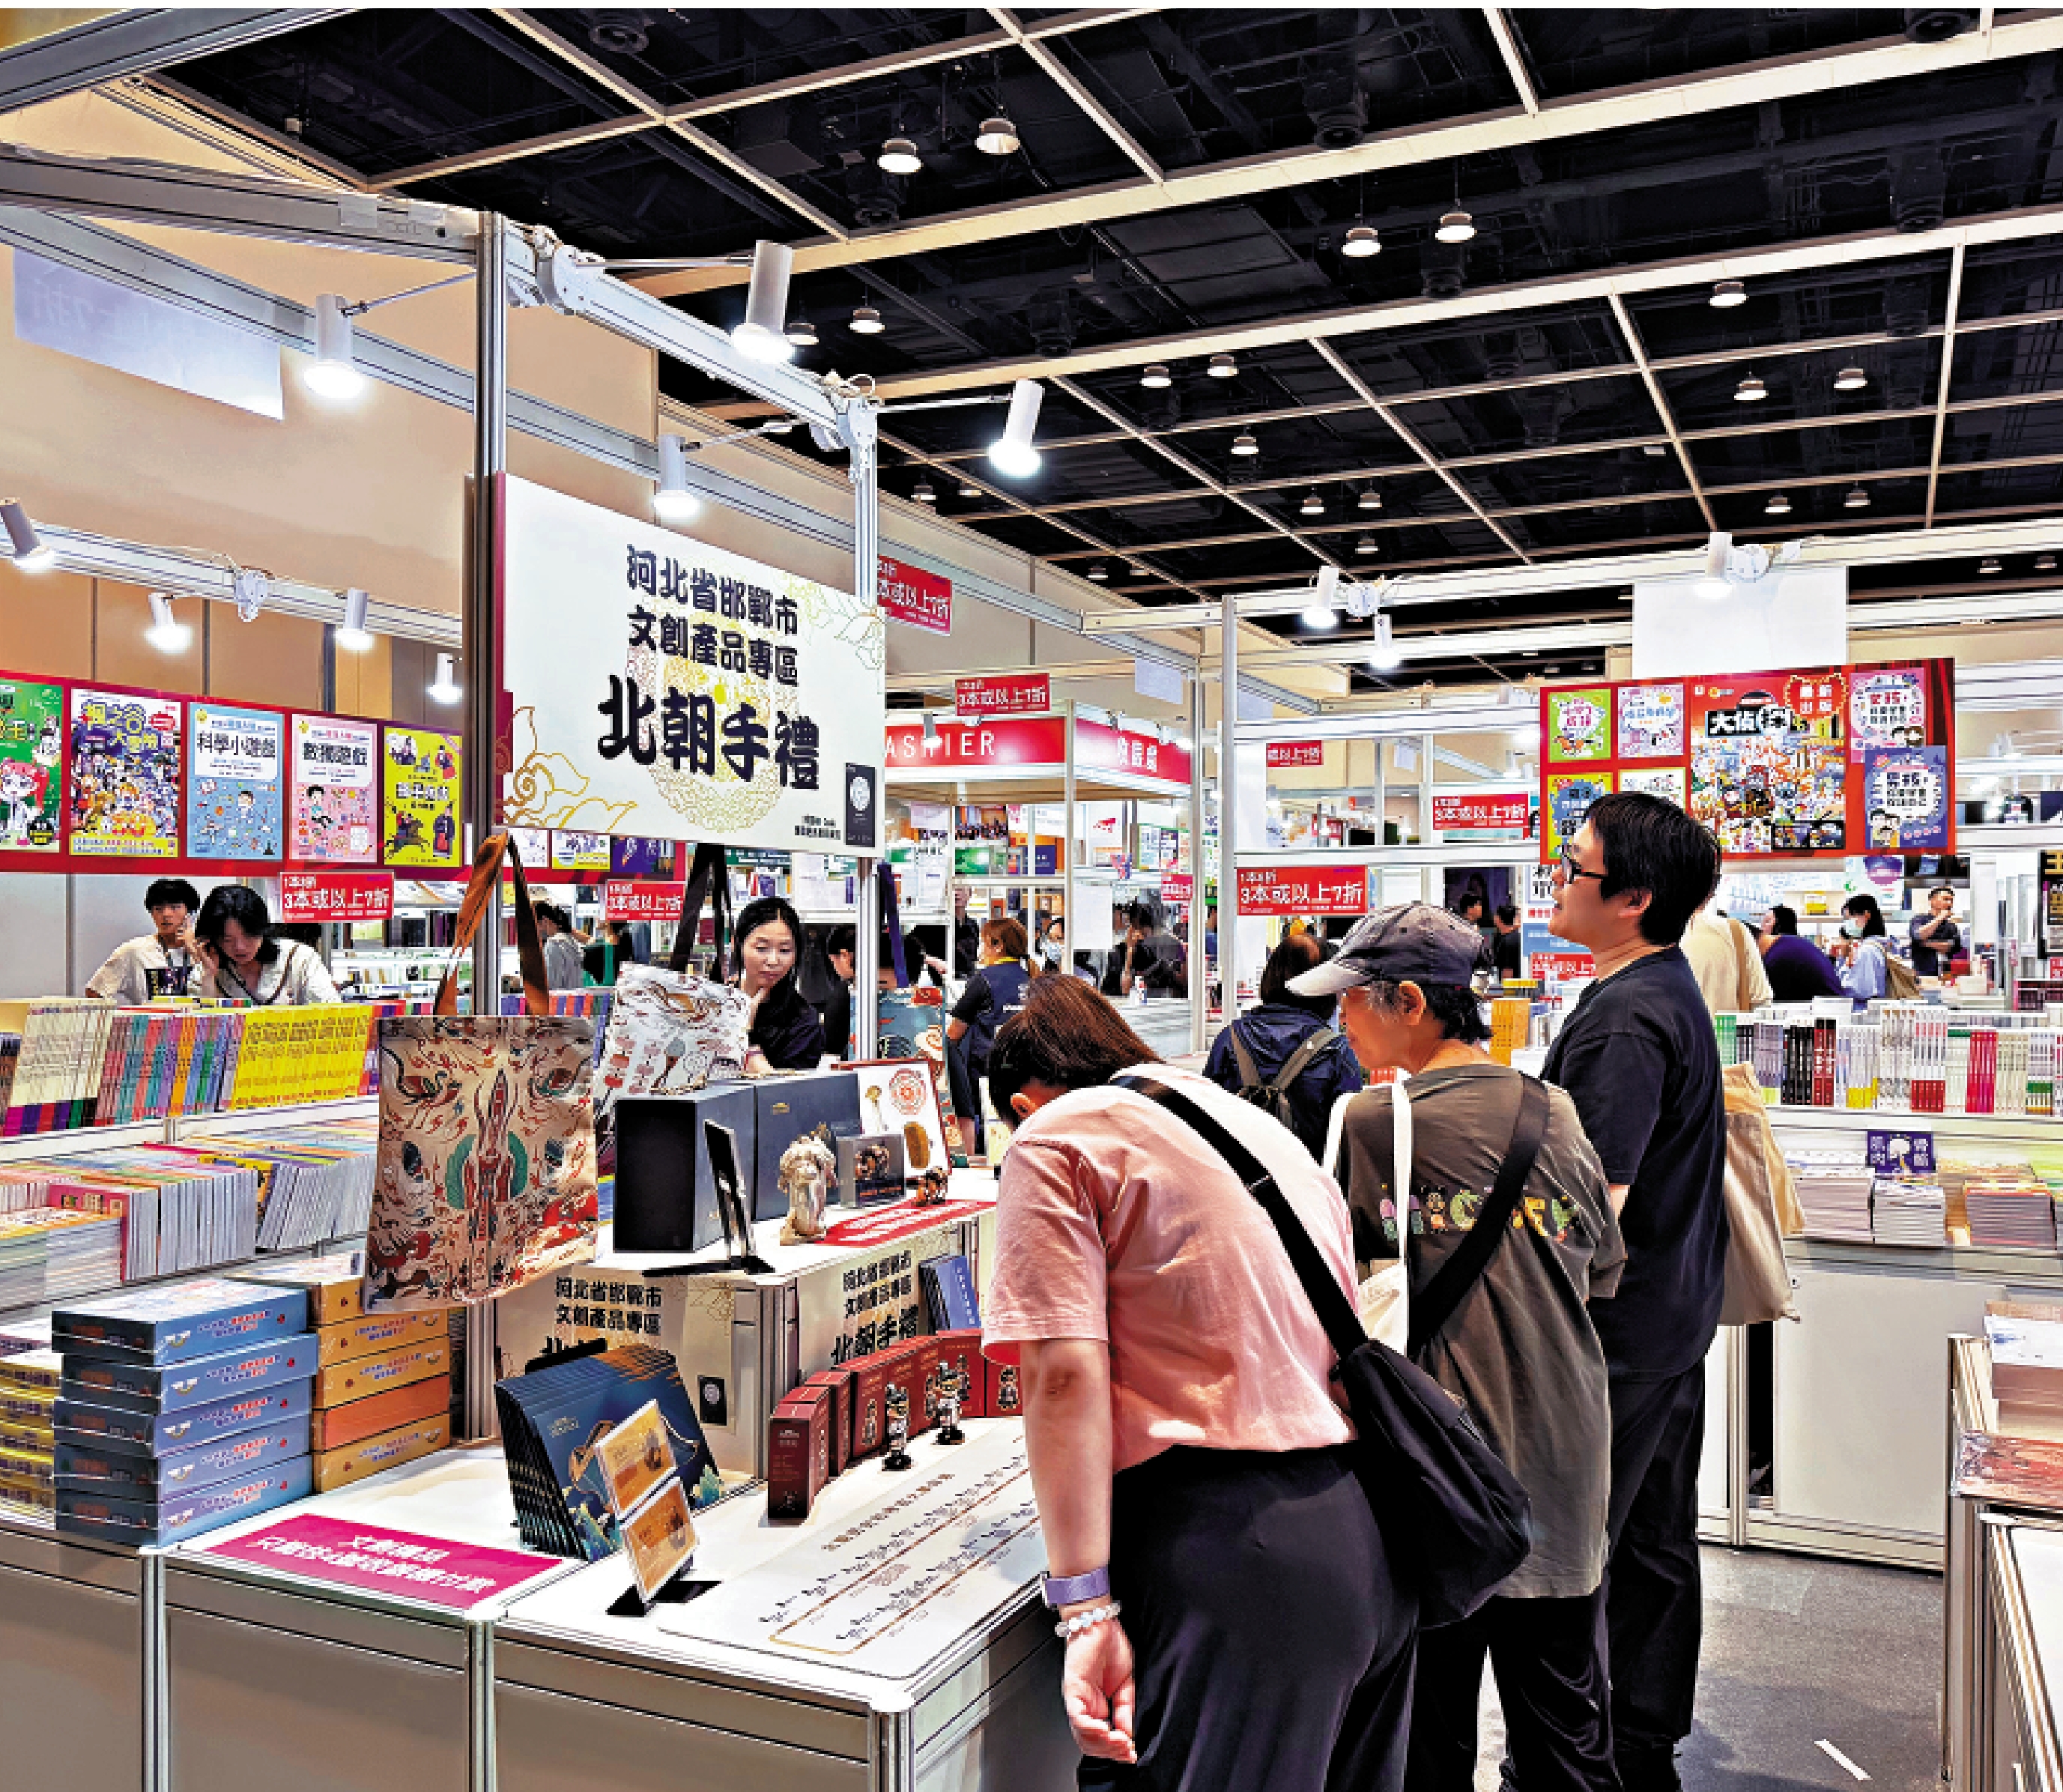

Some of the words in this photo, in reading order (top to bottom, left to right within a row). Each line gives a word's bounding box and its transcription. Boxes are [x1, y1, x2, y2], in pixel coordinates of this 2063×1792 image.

[627, 545, 798, 635] 河北省邯鄲市
[879, 578, 950, 620] 本或以上7折
[628, 605, 798, 687] 文創產品專區
[598, 674, 820, 791] 北朝手禮
[1709, 708, 1790, 736] 大偵探
[885, 731, 995, 759] ASHIER
[284, 888, 390, 909] 3本或以上7折
[1240, 881, 1363, 904] 3本或以上7折
[555, 1277, 662, 1307] 河北省邯鄲市
[556, 1304, 661, 1335] 文創產品專區
[831, 1305, 918, 1365] 北朝手禮
